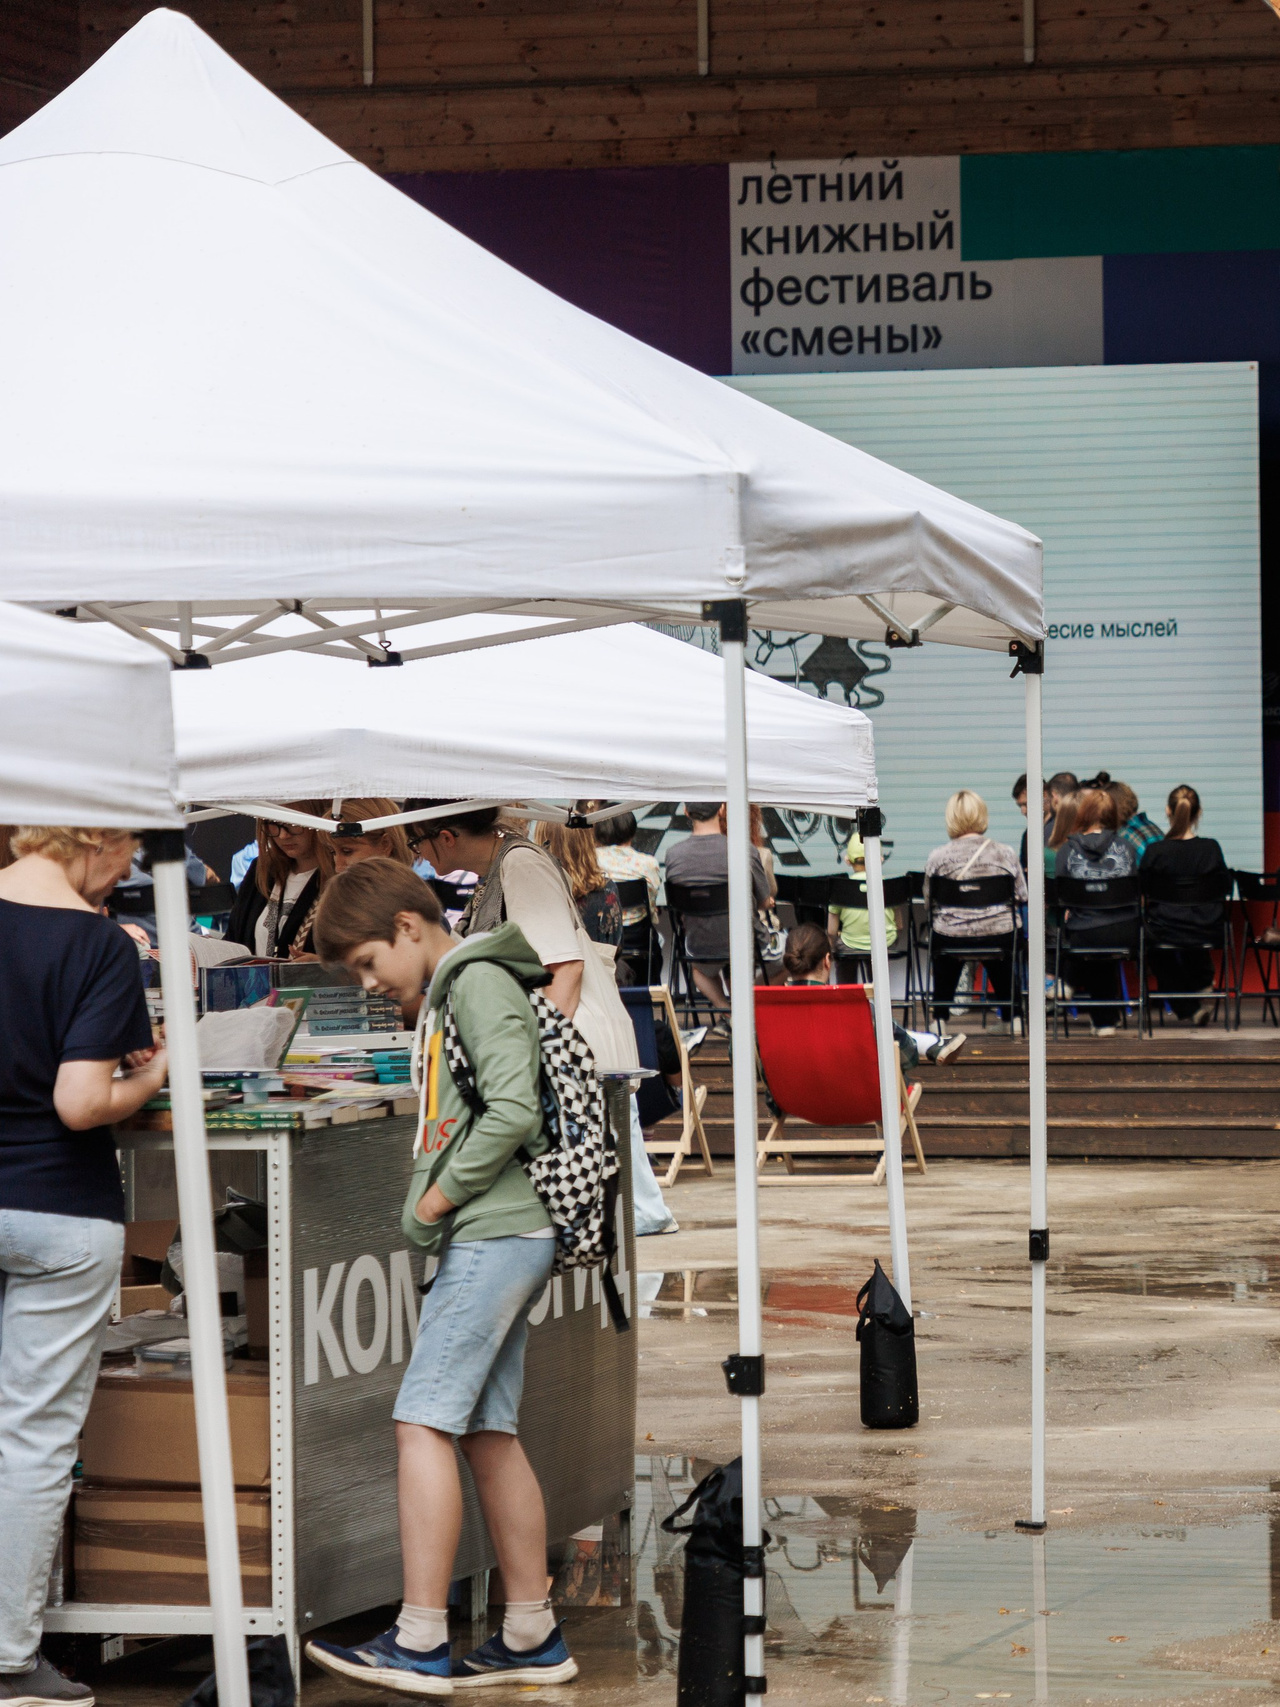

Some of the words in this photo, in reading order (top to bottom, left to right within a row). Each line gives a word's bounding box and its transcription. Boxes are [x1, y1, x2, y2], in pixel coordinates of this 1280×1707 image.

[738, 159, 904, 206] летний
[740, 209, 955, 256] книжный
[740, 266, 993, 317] фестиваль
[740, 324, 943, 358] «смены»
[1101, 618, 1178, 638] мыслей
